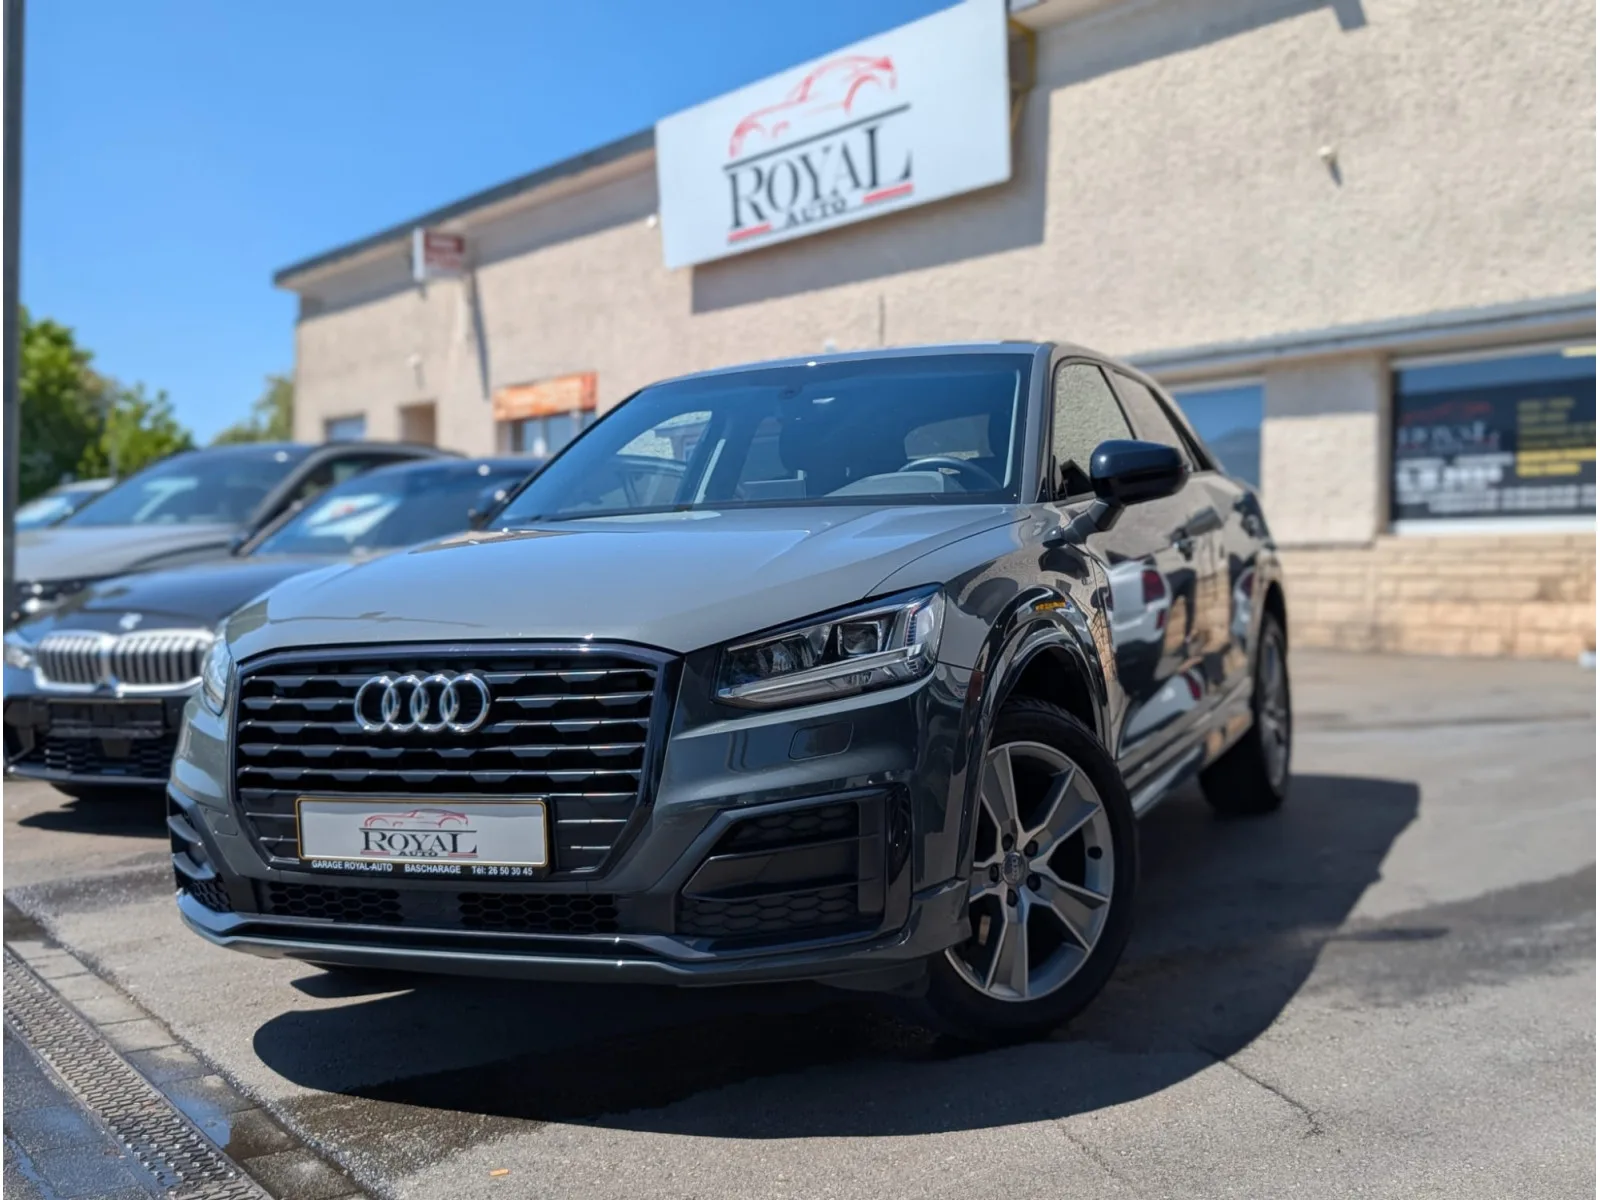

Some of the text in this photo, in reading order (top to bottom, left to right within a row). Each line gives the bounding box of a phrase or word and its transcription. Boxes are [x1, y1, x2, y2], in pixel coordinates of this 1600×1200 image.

[726, 125, 913, 229] ROYAL
[785, 198, 847, 228] AUTO
[361, 830, 477, 854] ROYAL
[311, 860, 342, 869] GARAGE
[344, 861, 393, 872] ROYAL-AUTO
[404, 863, 461, 874] BASCHARAGE
[488, 865, 498, 875] 26
[500, 866, 509, 875] 50
[511, 866, 520, 876] 30
[522, 867, 533, 876] 45
